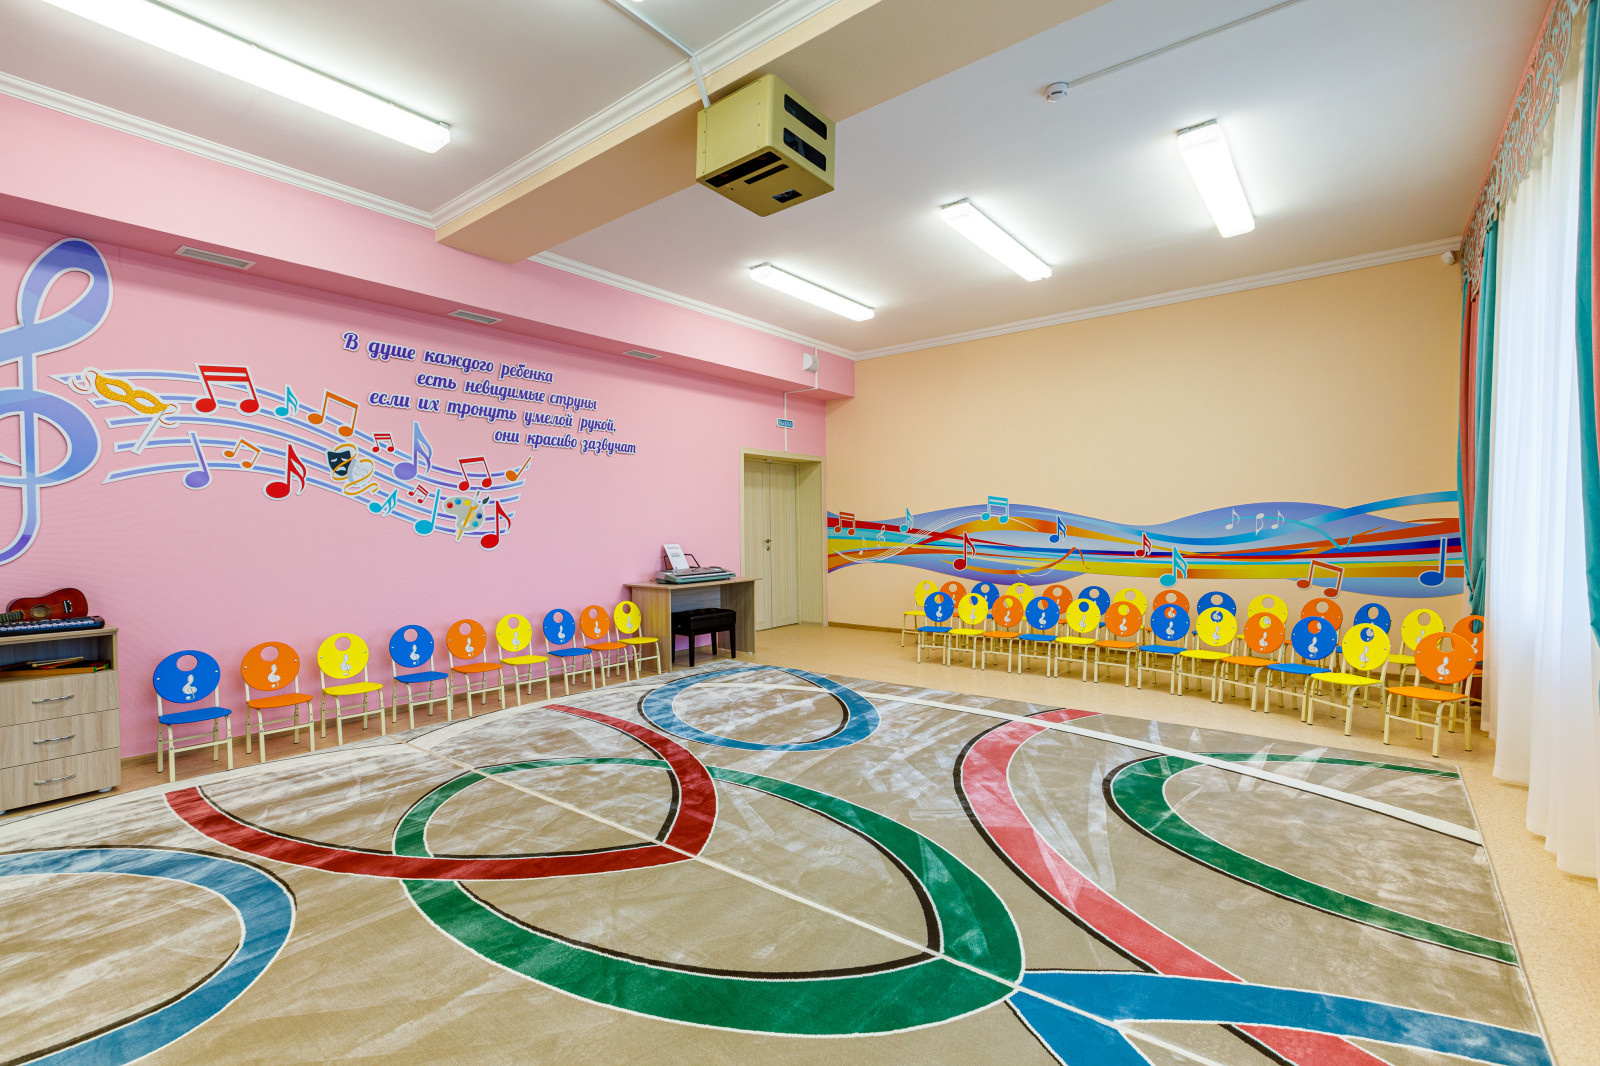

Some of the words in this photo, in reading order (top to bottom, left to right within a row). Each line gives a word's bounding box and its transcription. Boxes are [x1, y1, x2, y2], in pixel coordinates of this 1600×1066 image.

[343, 332, 359, 350] В
[368, 341, 416, 360] душе
[424, 350, 494, 373] каждого
[500, 363, 554, 383] ребенка
[417, 373, 457, 390] есть
[465, 379, 546, 401] невидимые
[549, 393, 597, 411] струны
[369, 392, 410, 408] если
[418, 398, 440, 412] их
[447, 401, 517, 422] тронуть
[524, 411, 573, 427] умелой
[579, 417, 616, 433] рукой,
[494, 430, 520, 443] они
[526, 433, 578, 449] красиво
[581, 438, 637, 455] зазвучат
